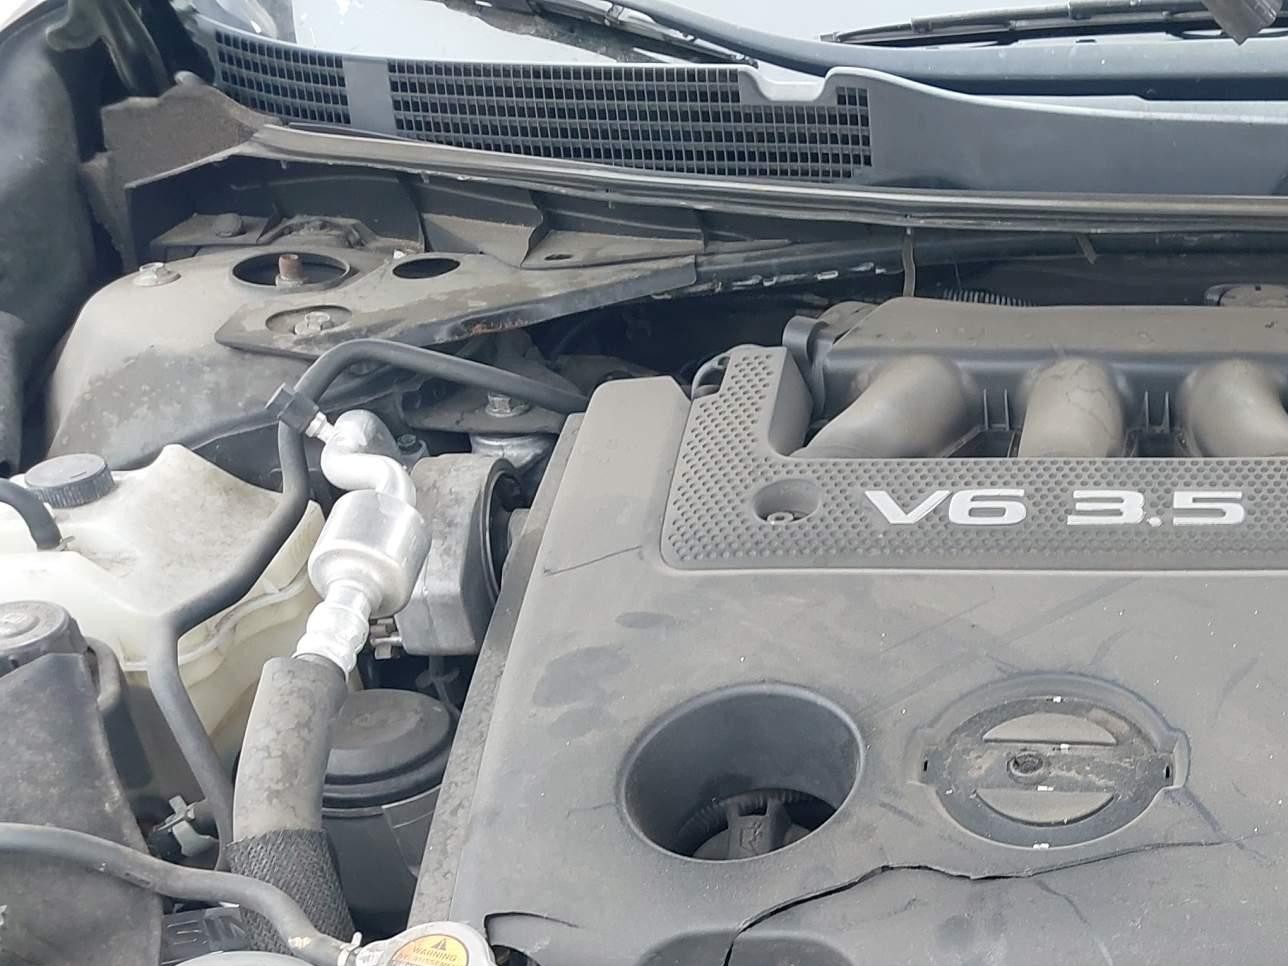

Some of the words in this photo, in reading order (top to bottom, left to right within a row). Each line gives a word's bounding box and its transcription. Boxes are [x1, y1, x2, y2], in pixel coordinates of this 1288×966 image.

[865, 489, 1027, 525] V6
[1067, 490, 1245, 526] 3.5
[413, 945, 457, 961] WARNING
